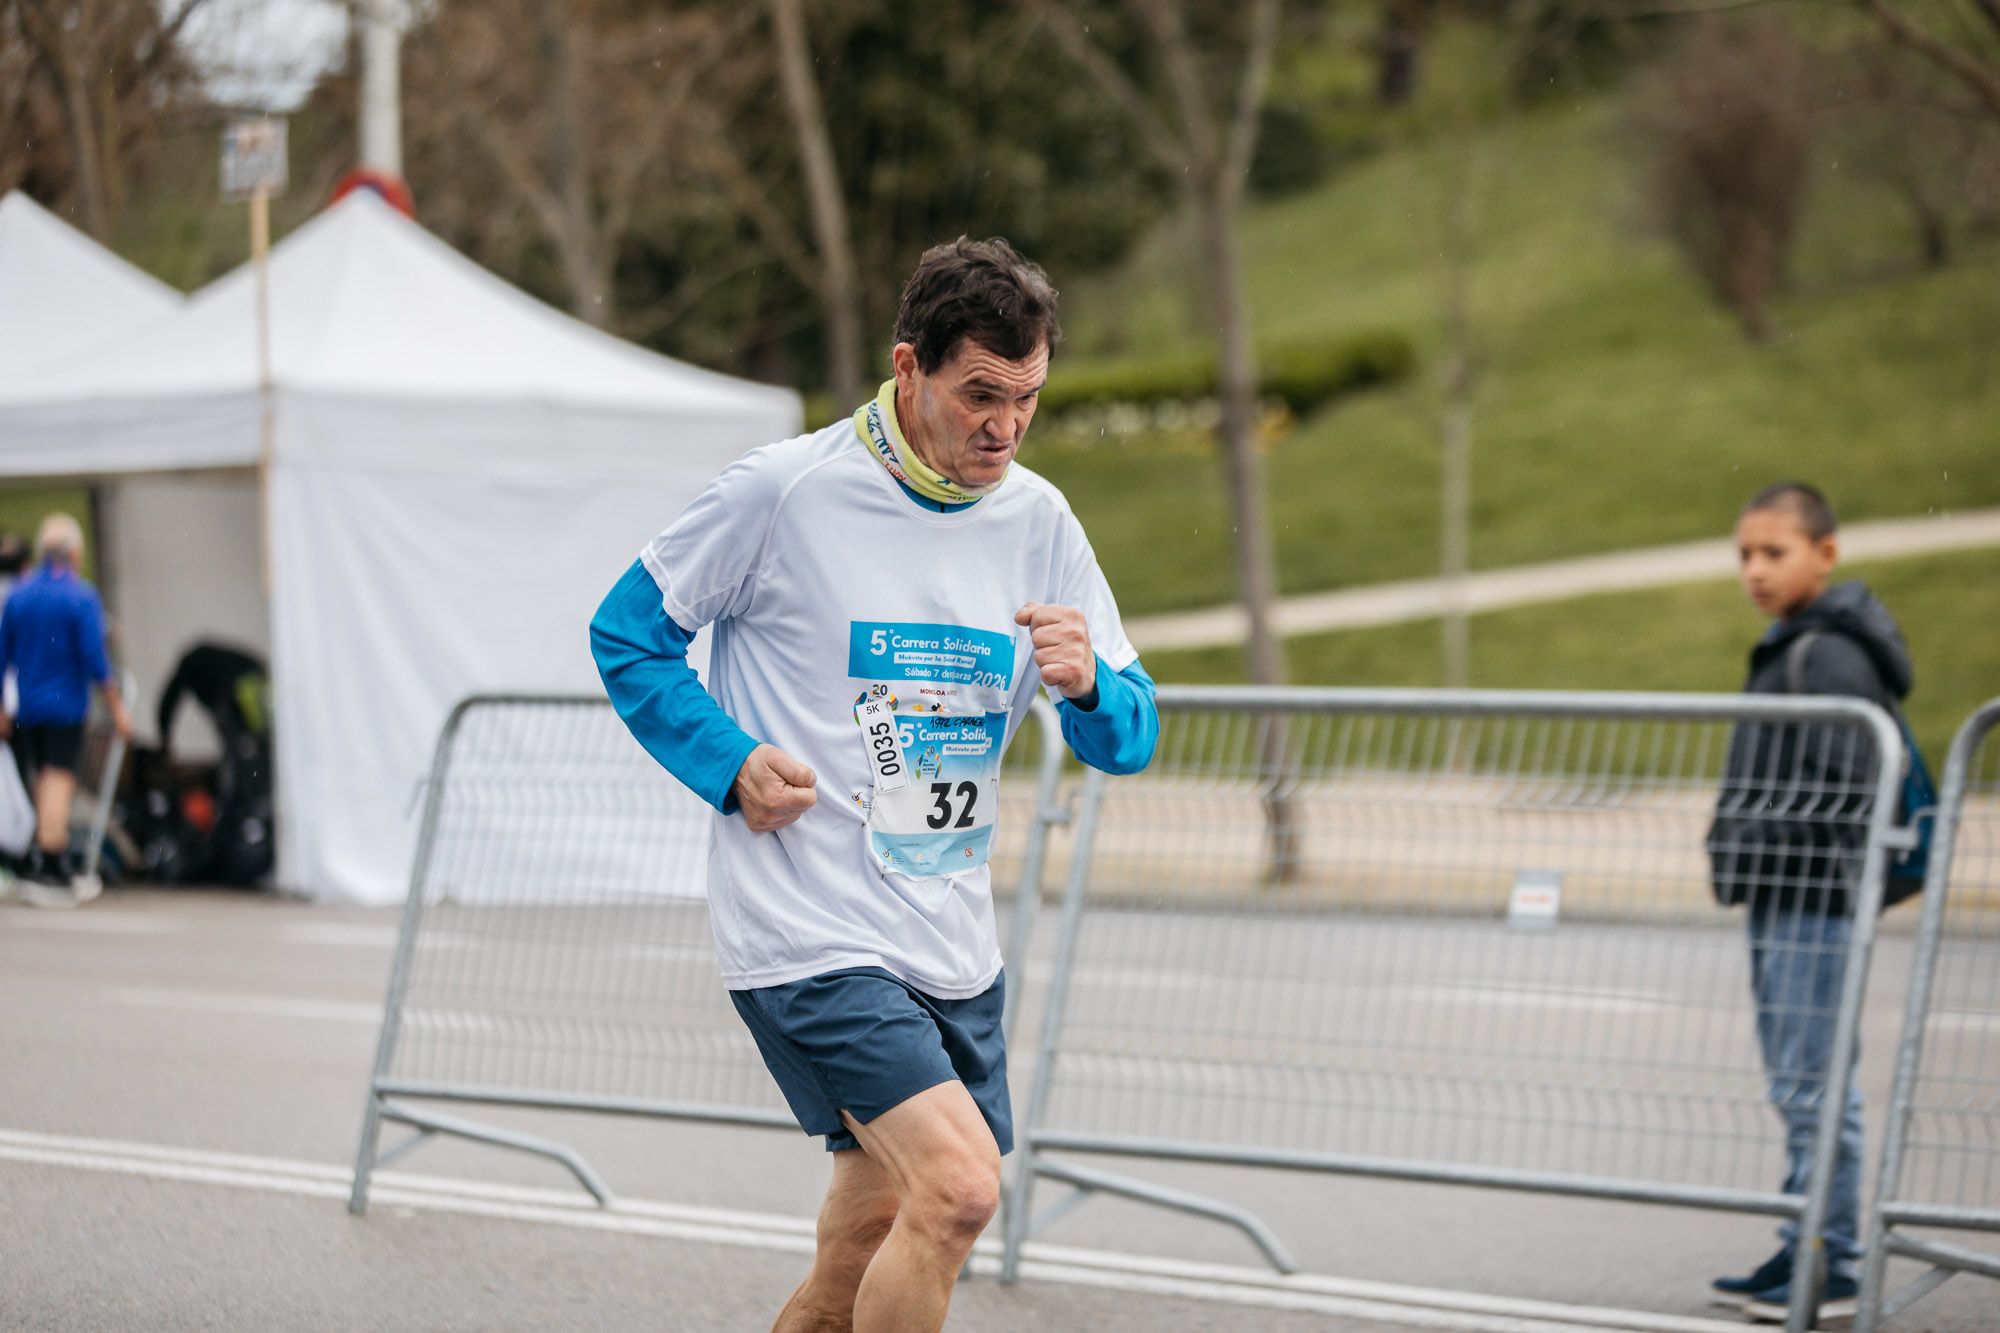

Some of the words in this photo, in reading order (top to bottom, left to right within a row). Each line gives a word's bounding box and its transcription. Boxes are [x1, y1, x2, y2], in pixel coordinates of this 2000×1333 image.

[892, 636, 939, 650] Carrera
[943, 637, 991, 656] Solidaria
[904, 667, 932, 678] Sábado
[934, 669, 940, 678] 7
[972, 671, 1007, 691] 2026
[872, 683, 888, 696] 20
[866, 703, 880, 715] 5K
[919, 729, 957, 742] Carrera
[869, 723, 901, 777] 0035
[926, 781, 978, 830] 32
